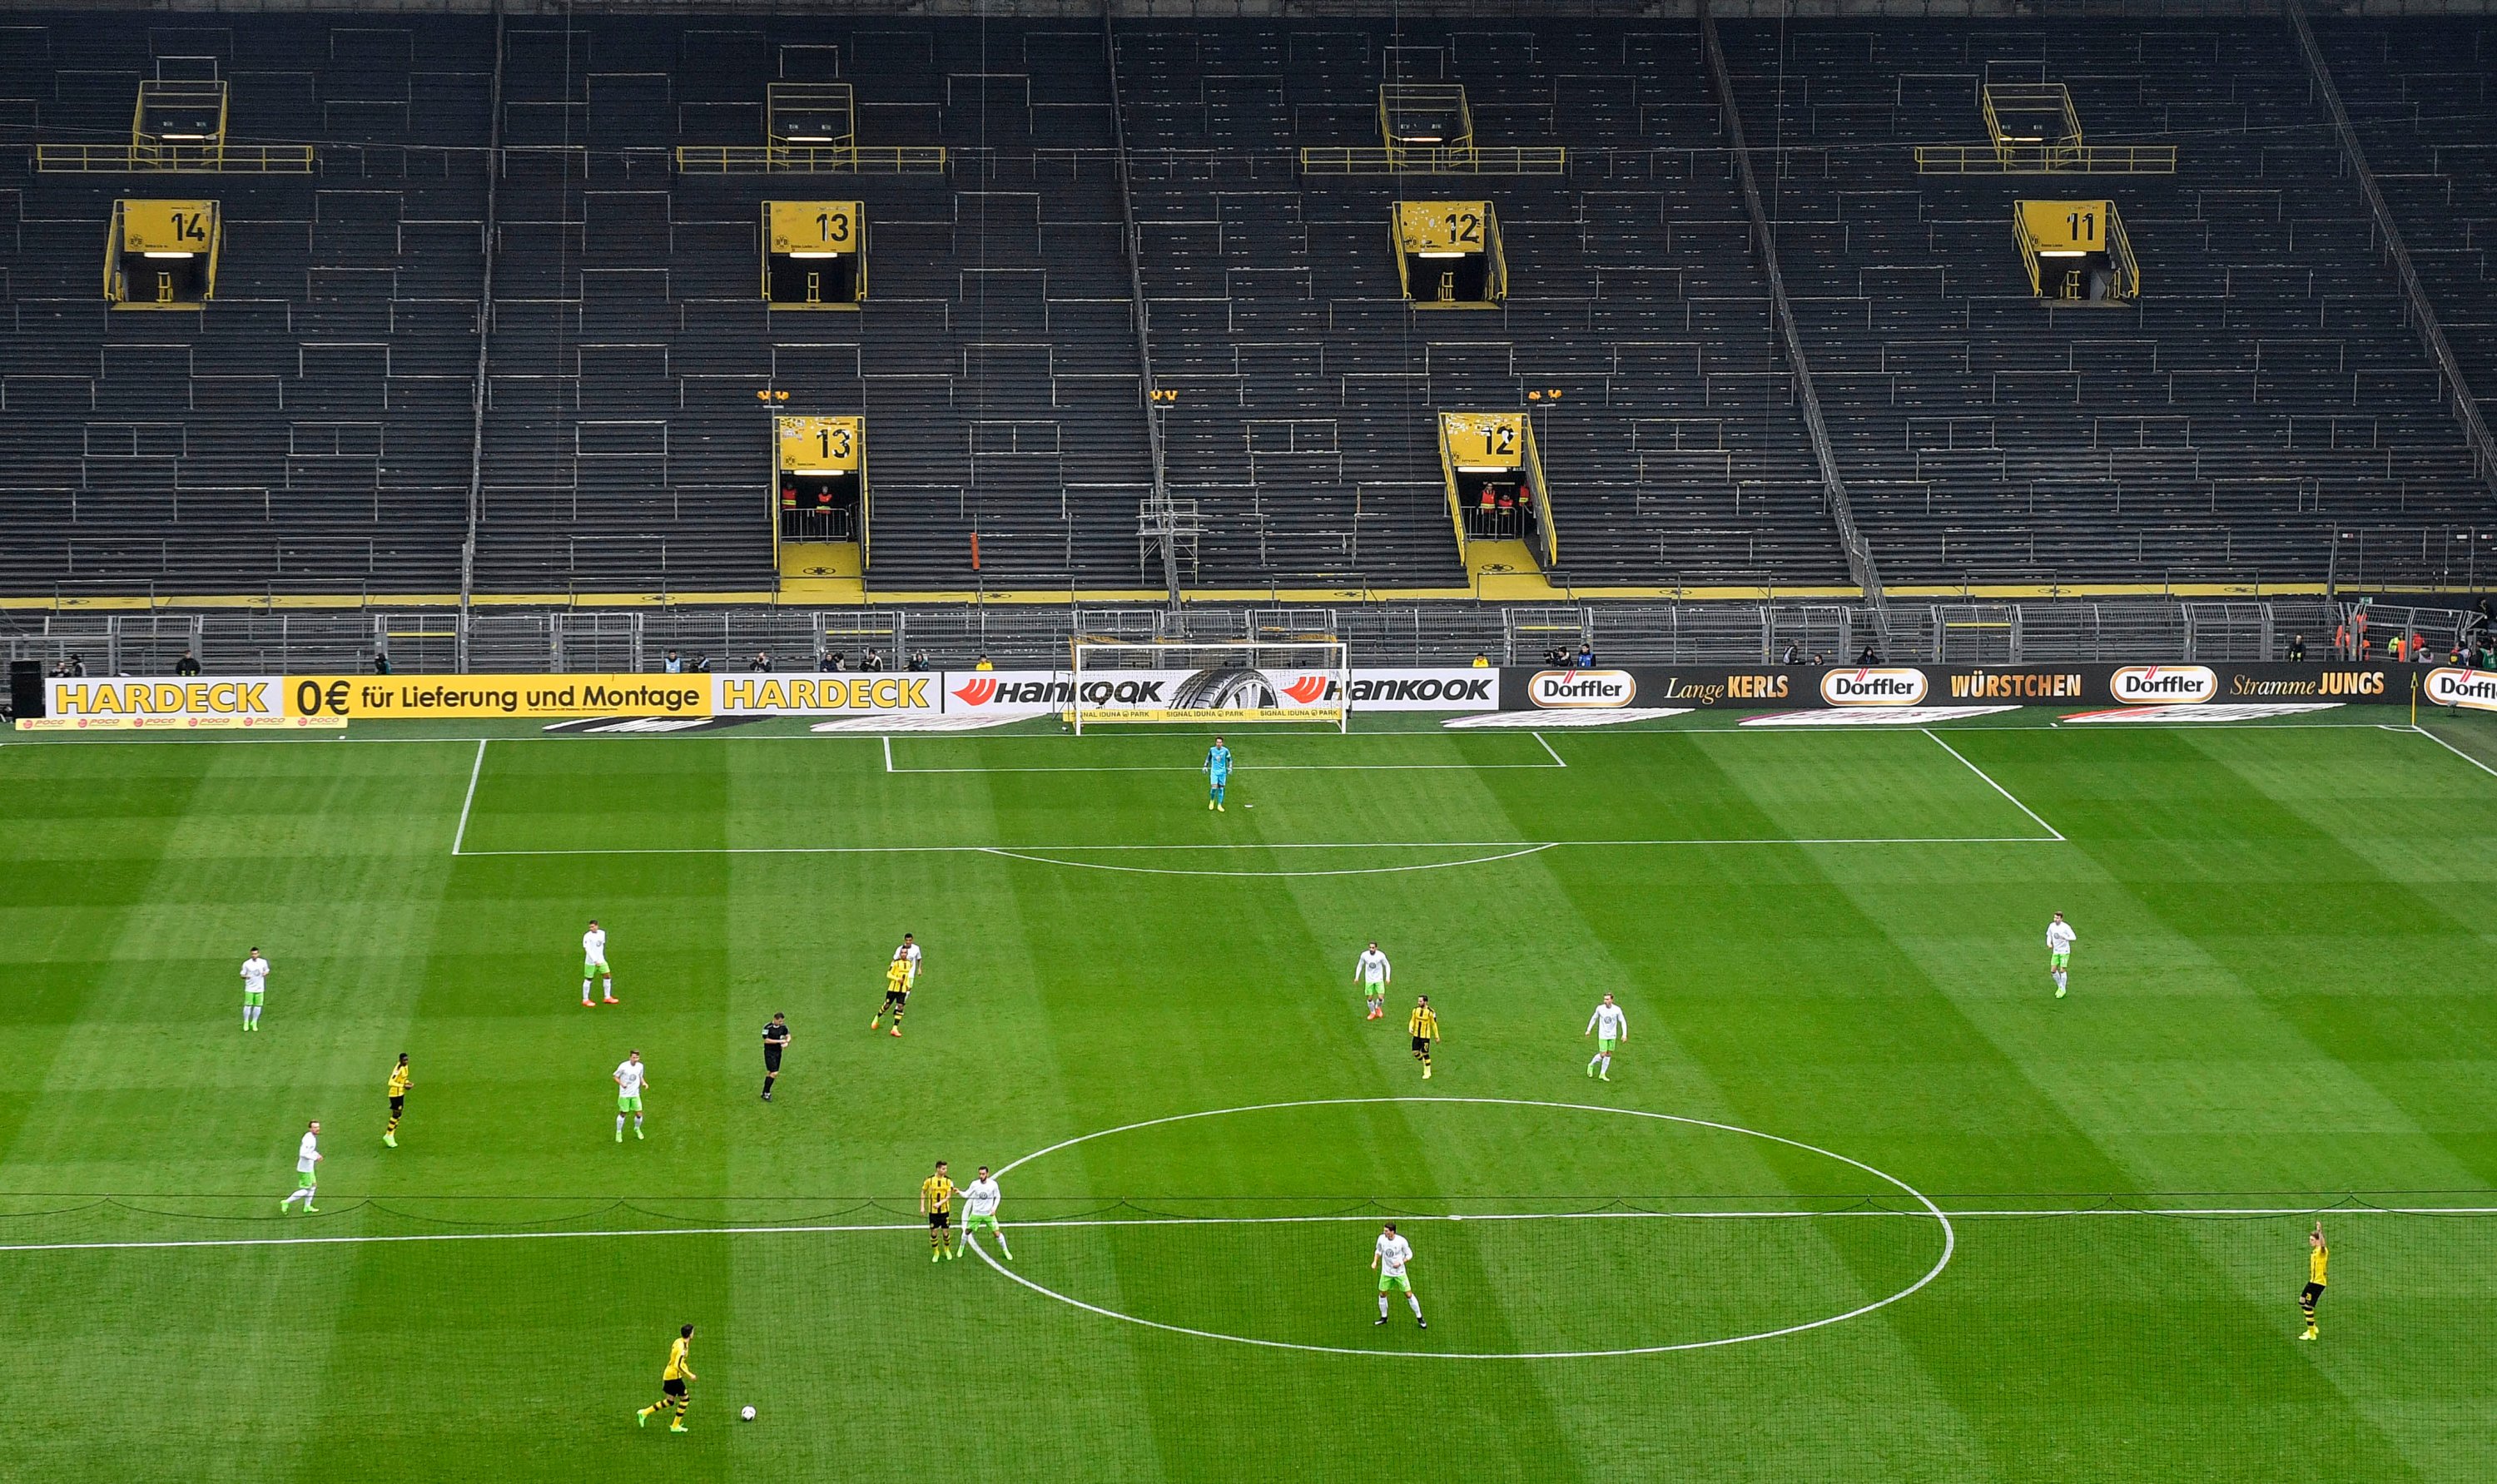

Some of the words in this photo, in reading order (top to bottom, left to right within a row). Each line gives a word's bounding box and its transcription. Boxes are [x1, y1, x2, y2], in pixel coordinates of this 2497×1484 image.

[171, 212, 206, 242] 14
[816, 213, 849, 242] 13
[1445, 213, 1479, 243] 12
[2067, 212, 2094, 241] 11
[816, 428, 851, 459] 13
[1482, 424, 1515, 455] 12
[56, 683, 270, 714] HARDECK
[297, 680, 351, 716] 0€
[361, 685, 395, 707] für
[402, 685, 518, 712] Lieferung
[526, 685, 574, 707] und
[583, 685, 700, 712] Montage
[723, 678, 931, 709] HARDECK
[1664, 677, 1725, 705] Lange
[1727, 674, 1789, 699] KERLS
[1950, 670, 2082, 697] WÜRSTCHEN
[2230, 673, 2316, 696] Stramme
[2317, 672, 2385, 696] JUNGS
[2440, 671, 2497, 700] Dörffl
